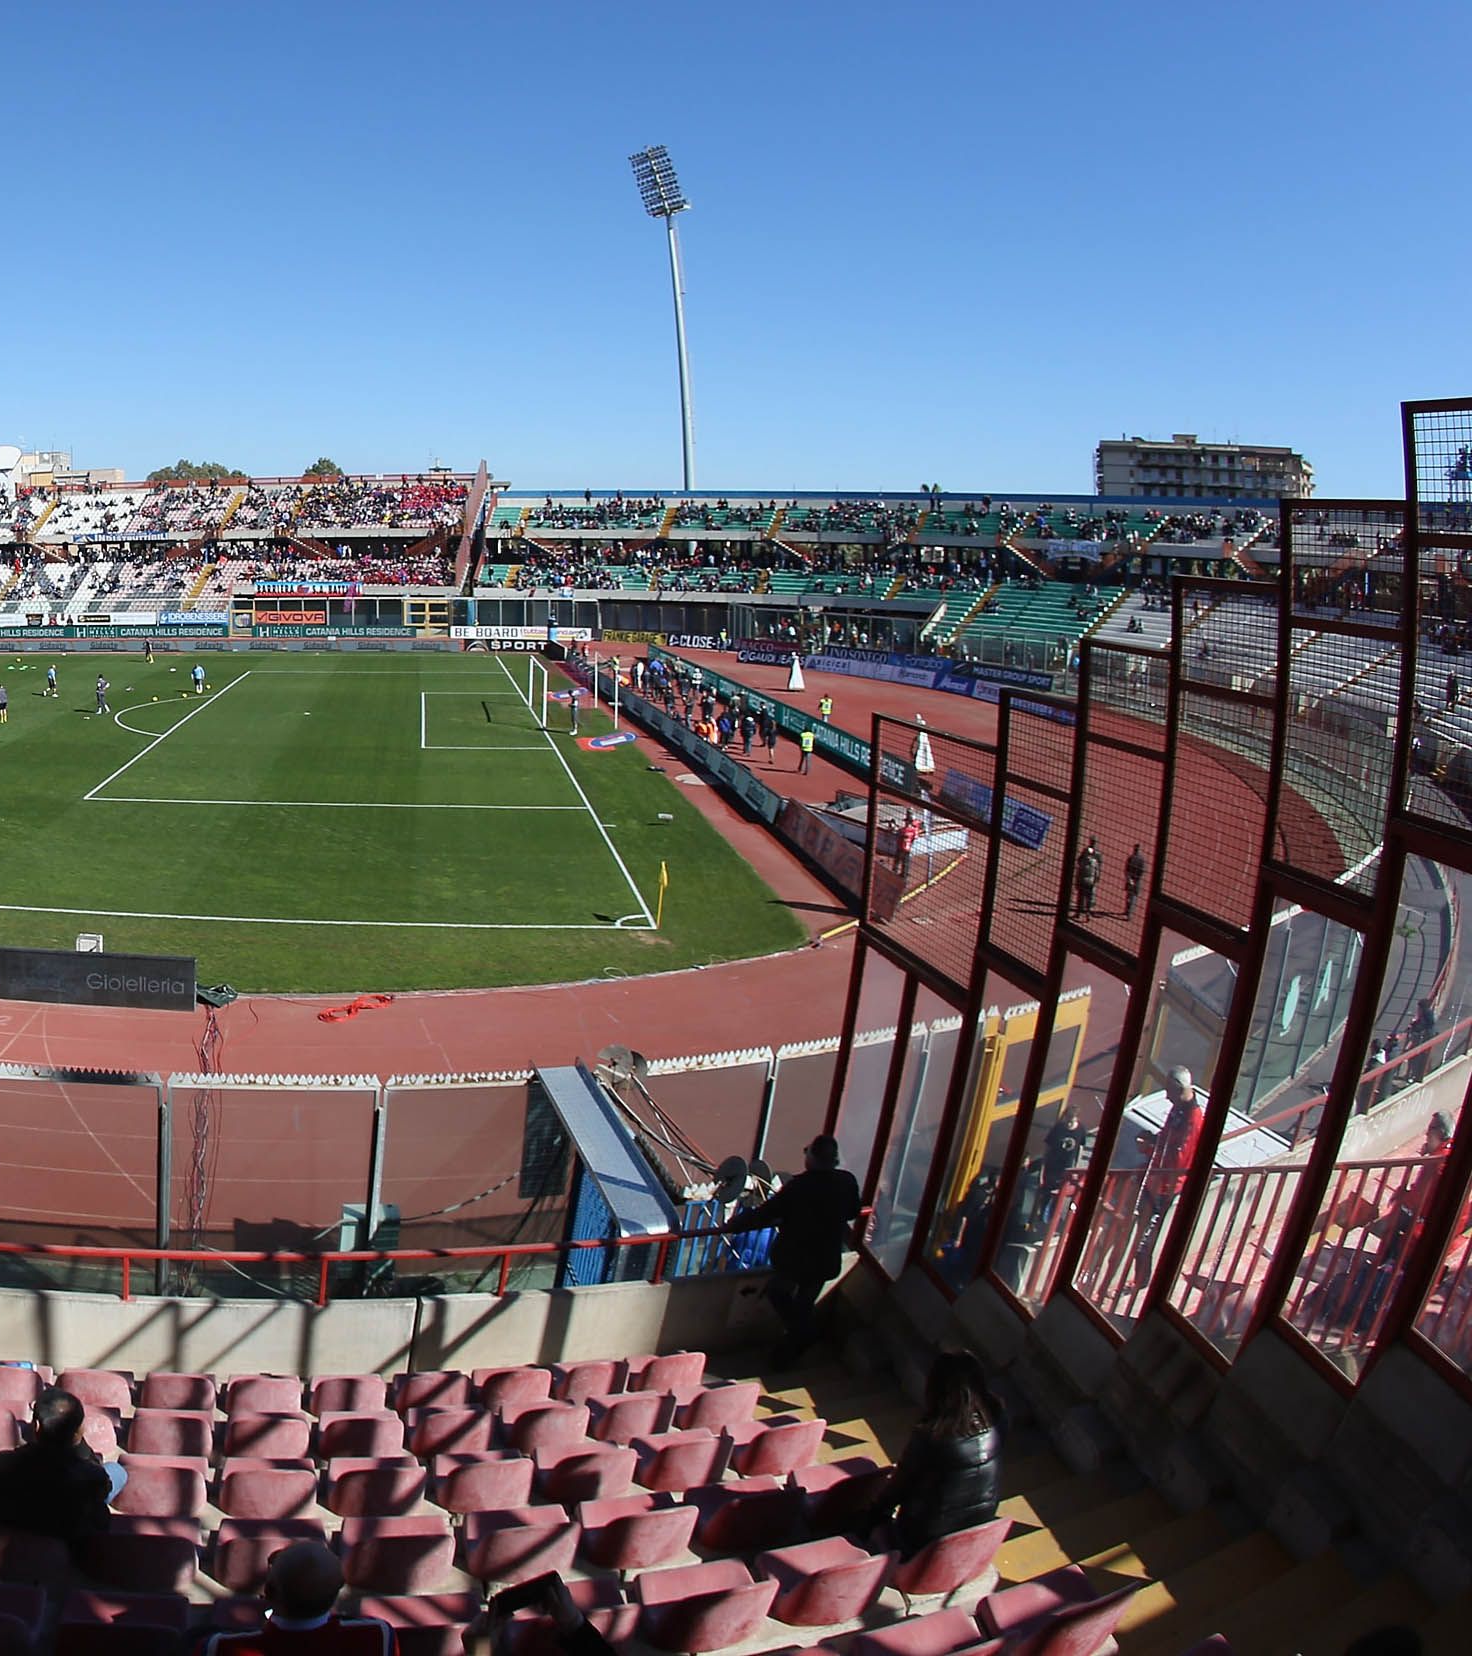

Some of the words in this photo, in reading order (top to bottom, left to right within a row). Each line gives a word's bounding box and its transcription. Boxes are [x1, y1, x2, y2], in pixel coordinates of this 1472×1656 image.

[168, 612, 227, 621] IDROBENESSERE
[268, 612, 324, 621] GIVOVA
[0, 629, 21, 637] HILLS
[22, 628, 64, 637] RESIDENCE
[120, 628, 154, 637] CATANIA
[155, 628, 177, 636] HILLS
[178, 627, 224, 636] RESIDENCE
[305, 627, 341, 636] CATANIA
[342, 627, 365, 636] HILLS
[366, 627, 412, 636] RESIDENCE
[454, 627, 469, 637] BE
[476, 627, 518, 638] BOARD
[491, 640, 548, 651] SPORT
[972, 666, 1003, 679] MASTER
[1003, 670, 1027, 682] GROUP
[1028, 674, 1051, 687] SPORT
[86, 972, 185, 995] Gioielleria
